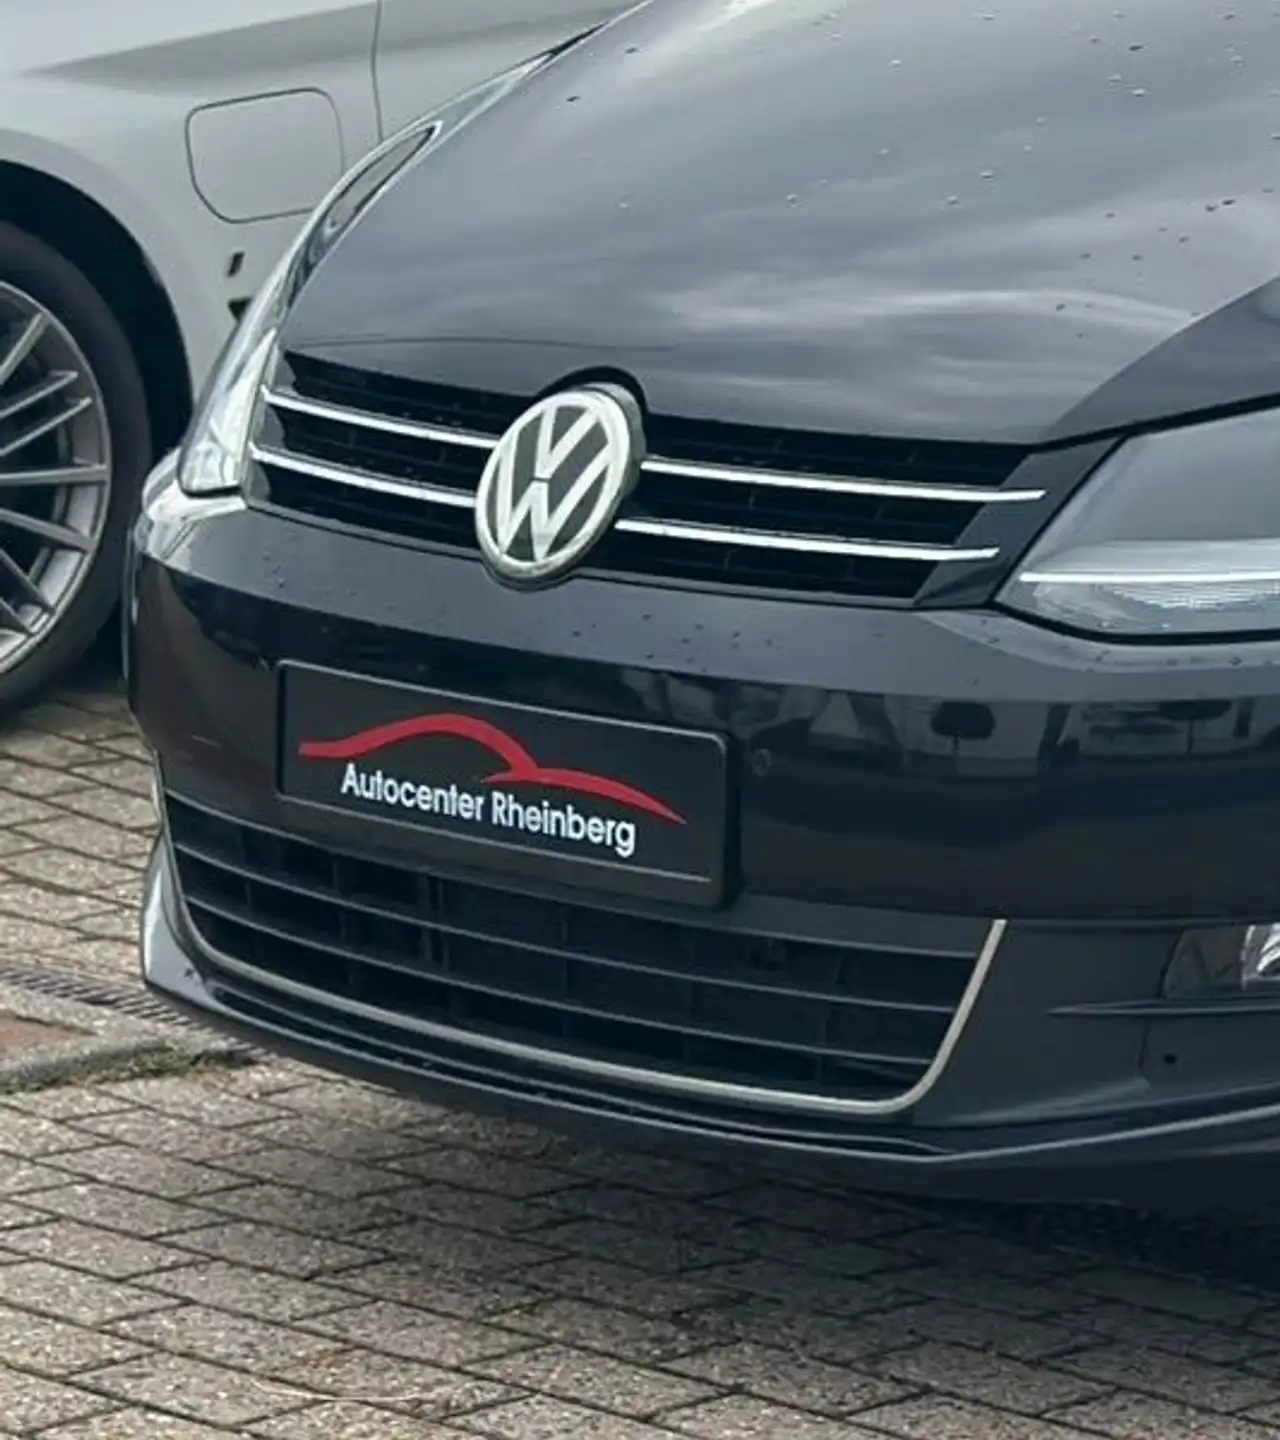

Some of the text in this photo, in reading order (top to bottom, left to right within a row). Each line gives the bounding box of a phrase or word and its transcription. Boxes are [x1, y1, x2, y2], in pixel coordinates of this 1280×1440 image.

[485, 396, 624, 570] VW
[339, 762, 637, 859] Autocenter Rheinberg
